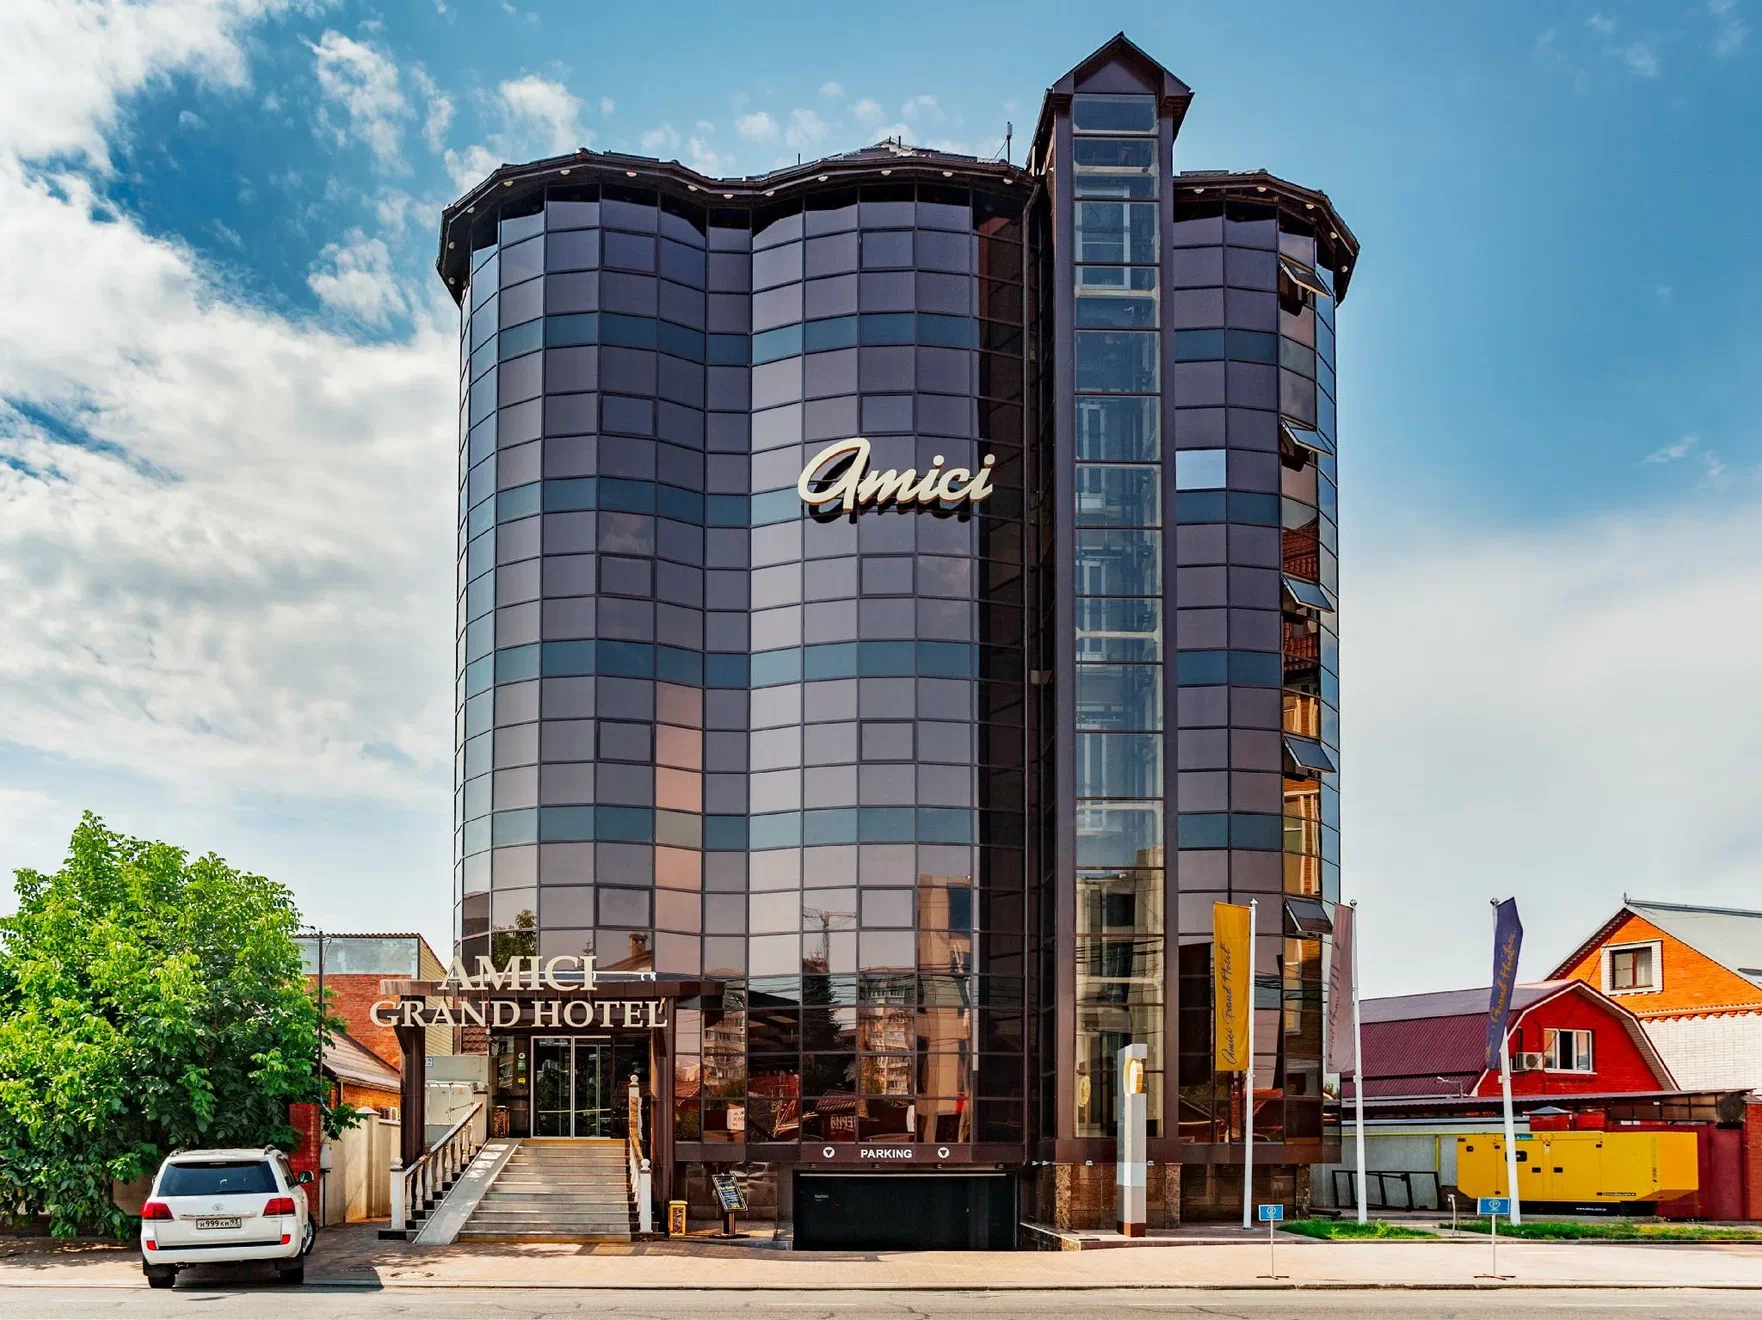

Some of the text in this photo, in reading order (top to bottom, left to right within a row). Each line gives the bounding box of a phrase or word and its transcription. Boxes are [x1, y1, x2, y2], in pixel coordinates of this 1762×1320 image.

[798, 437, 995, 512] Amici
[437, 955, 598, 992] AMICI
[369, 998, 669, 1028] GRAND HOTEL
[860, 1149, 913, 1159] PARKING
